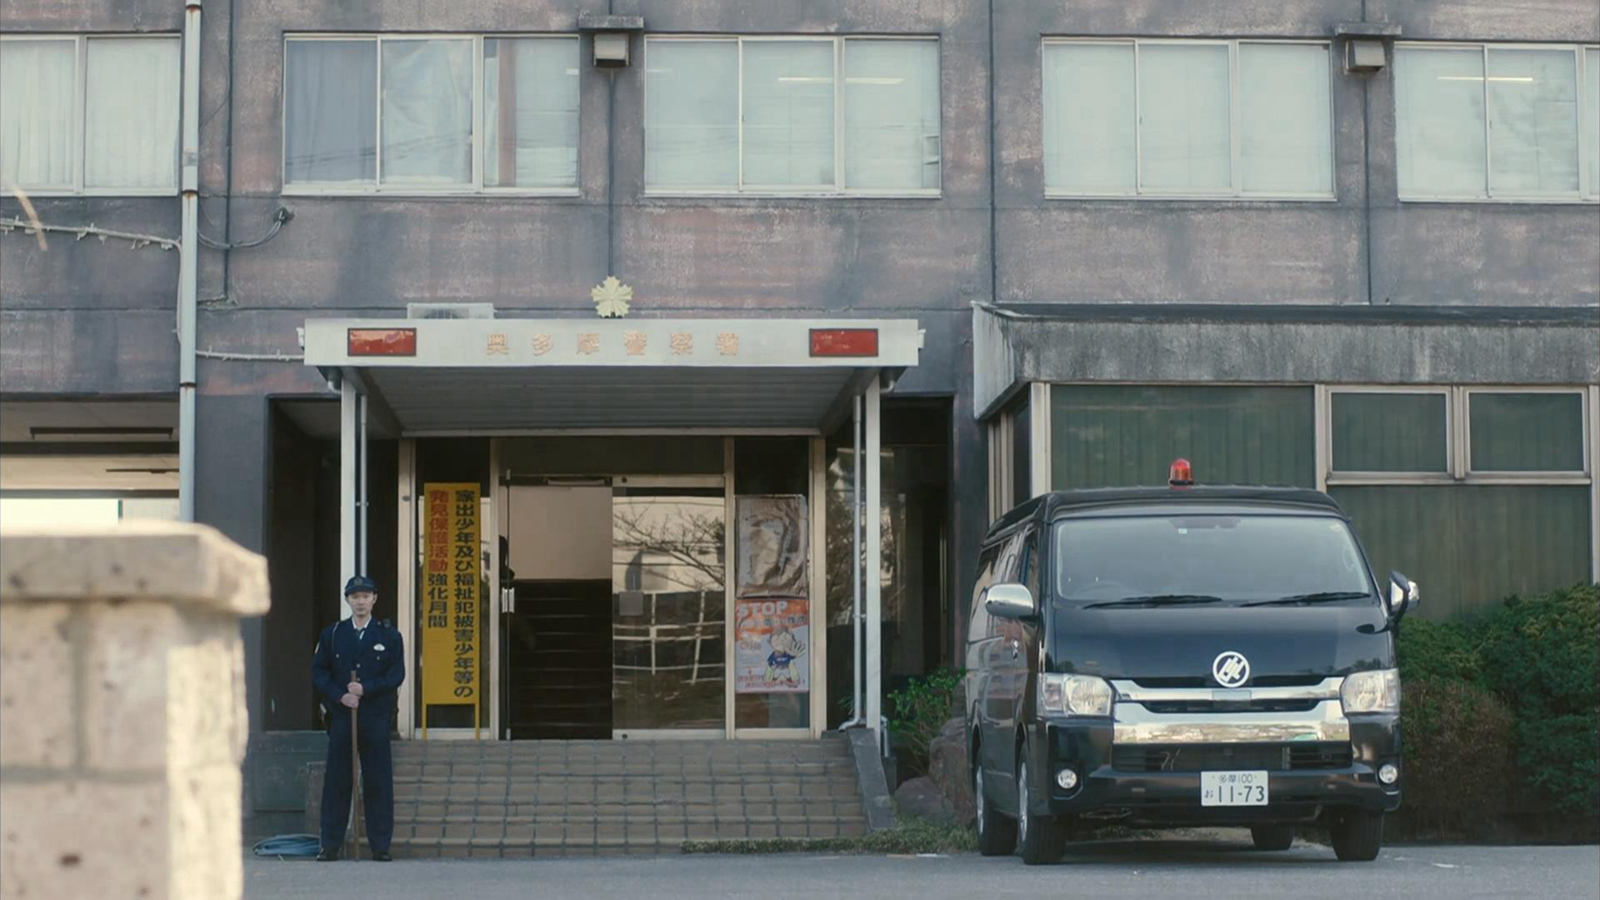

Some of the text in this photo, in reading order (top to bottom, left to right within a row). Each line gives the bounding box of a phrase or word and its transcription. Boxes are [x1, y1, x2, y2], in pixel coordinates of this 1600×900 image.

[486, 332, 740, 357] 奥多摩警察署
[736, 600, 788, 618] STOP
[1218, 785, 1265, 803] 11-73
